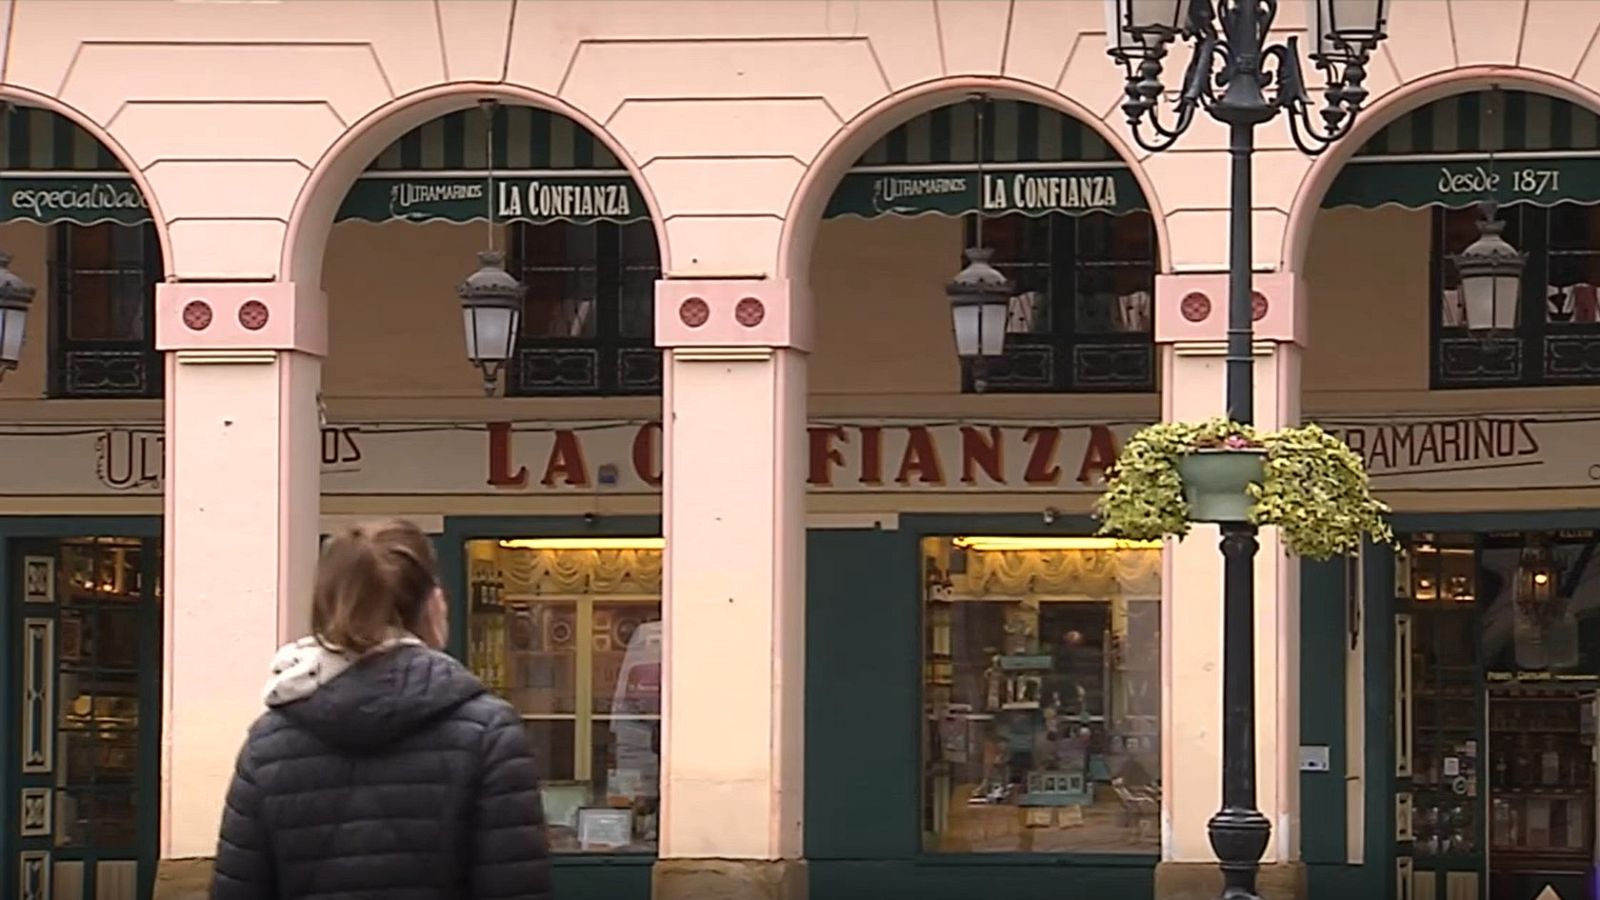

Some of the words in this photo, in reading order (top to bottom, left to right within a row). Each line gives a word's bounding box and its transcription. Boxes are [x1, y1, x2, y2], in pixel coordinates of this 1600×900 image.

[400, 183, 482, 207] ULTRAMARINOS
[499, 182, 522, 216] LA
[528, 181, 631, 216] CONFIANZA
[884, 177, 966, 201] ULTRAMARINOS
[983, 174, 1007, 209] LA
[1013, 173, 1117, 209] CONFIANZA
[1438, 166, 1500, 193] desde
[1513, 168, 1560, 196] 1871
[486, 421, 592, 488] LA
[1323, 418, 1539, 469] RAMARINOS
